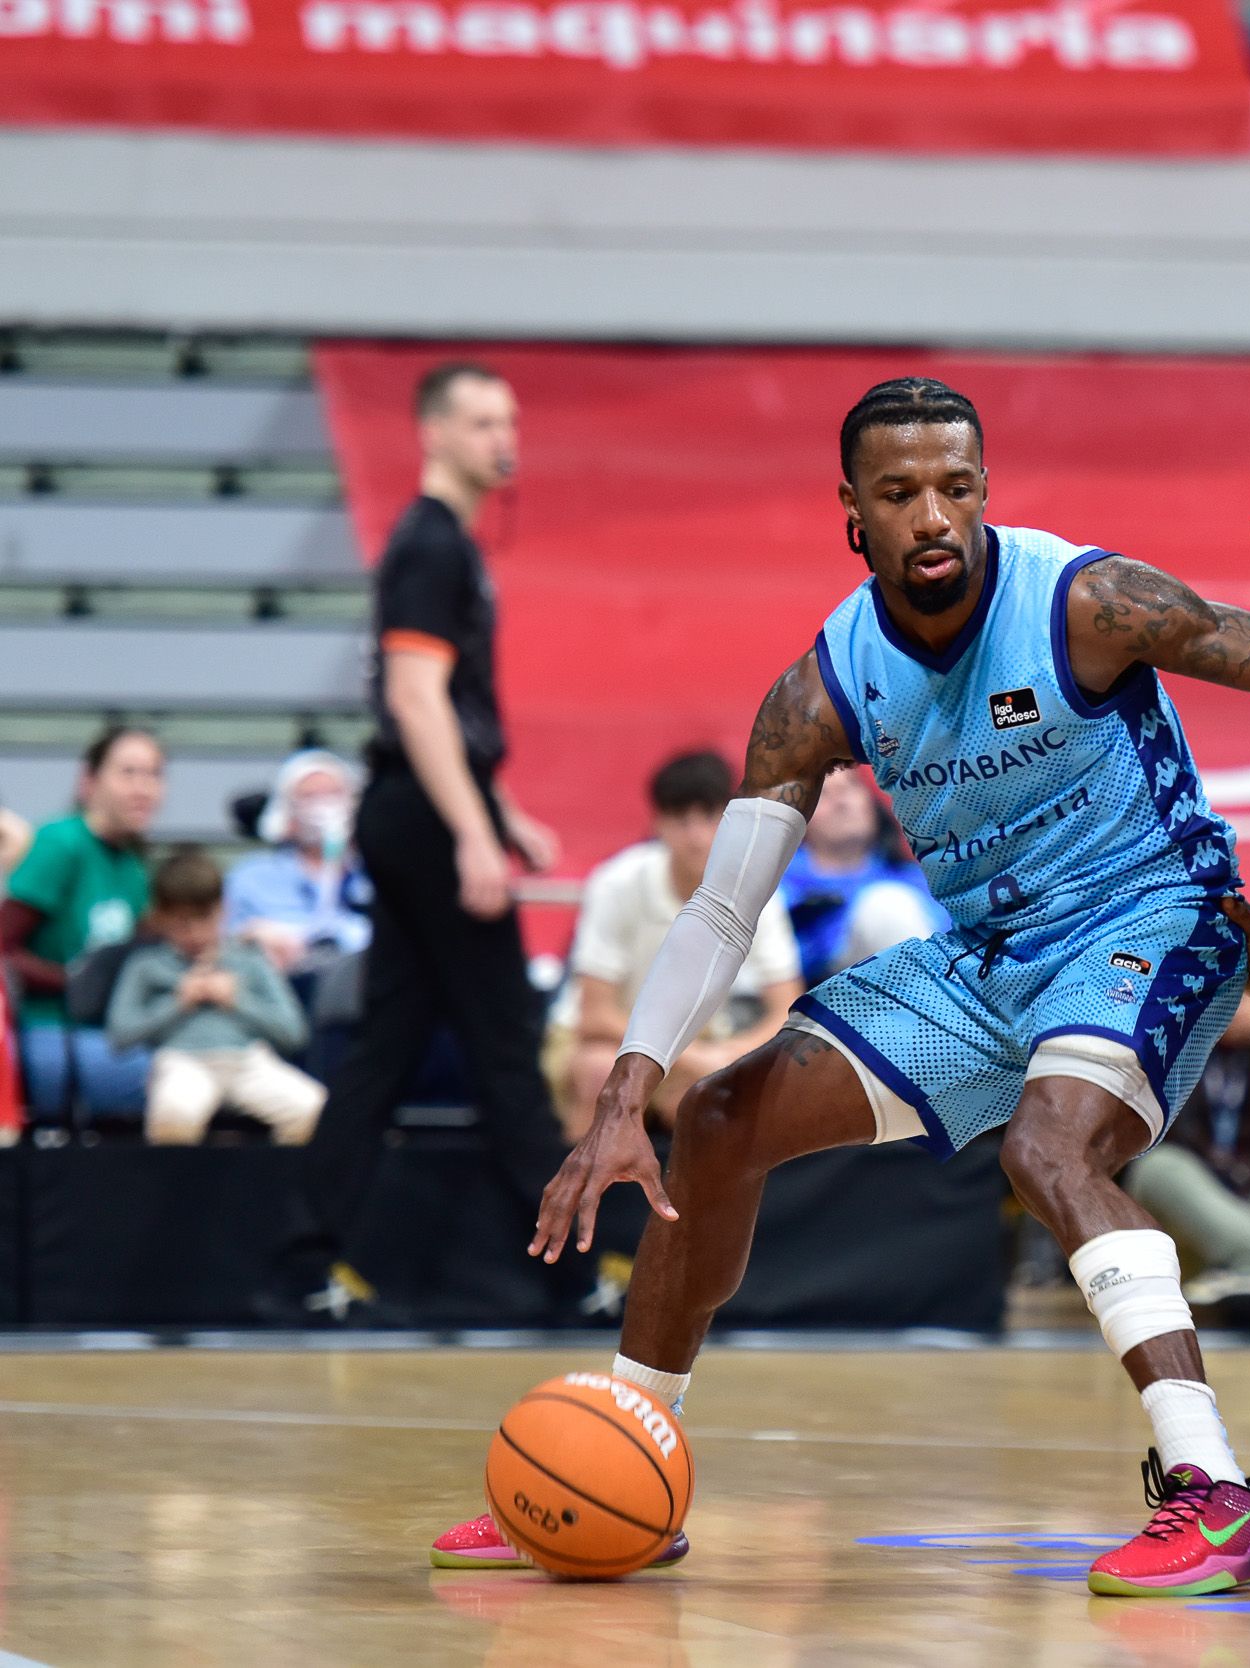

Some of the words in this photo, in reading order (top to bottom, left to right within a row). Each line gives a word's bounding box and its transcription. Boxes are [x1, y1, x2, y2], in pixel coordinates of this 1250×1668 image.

[993, 704, 1013, 716] liga
[996, 709, 1038, 726] endesa
[1113, 957, 1142, 973] acb
[513, 1490, 561, 1535] acb
